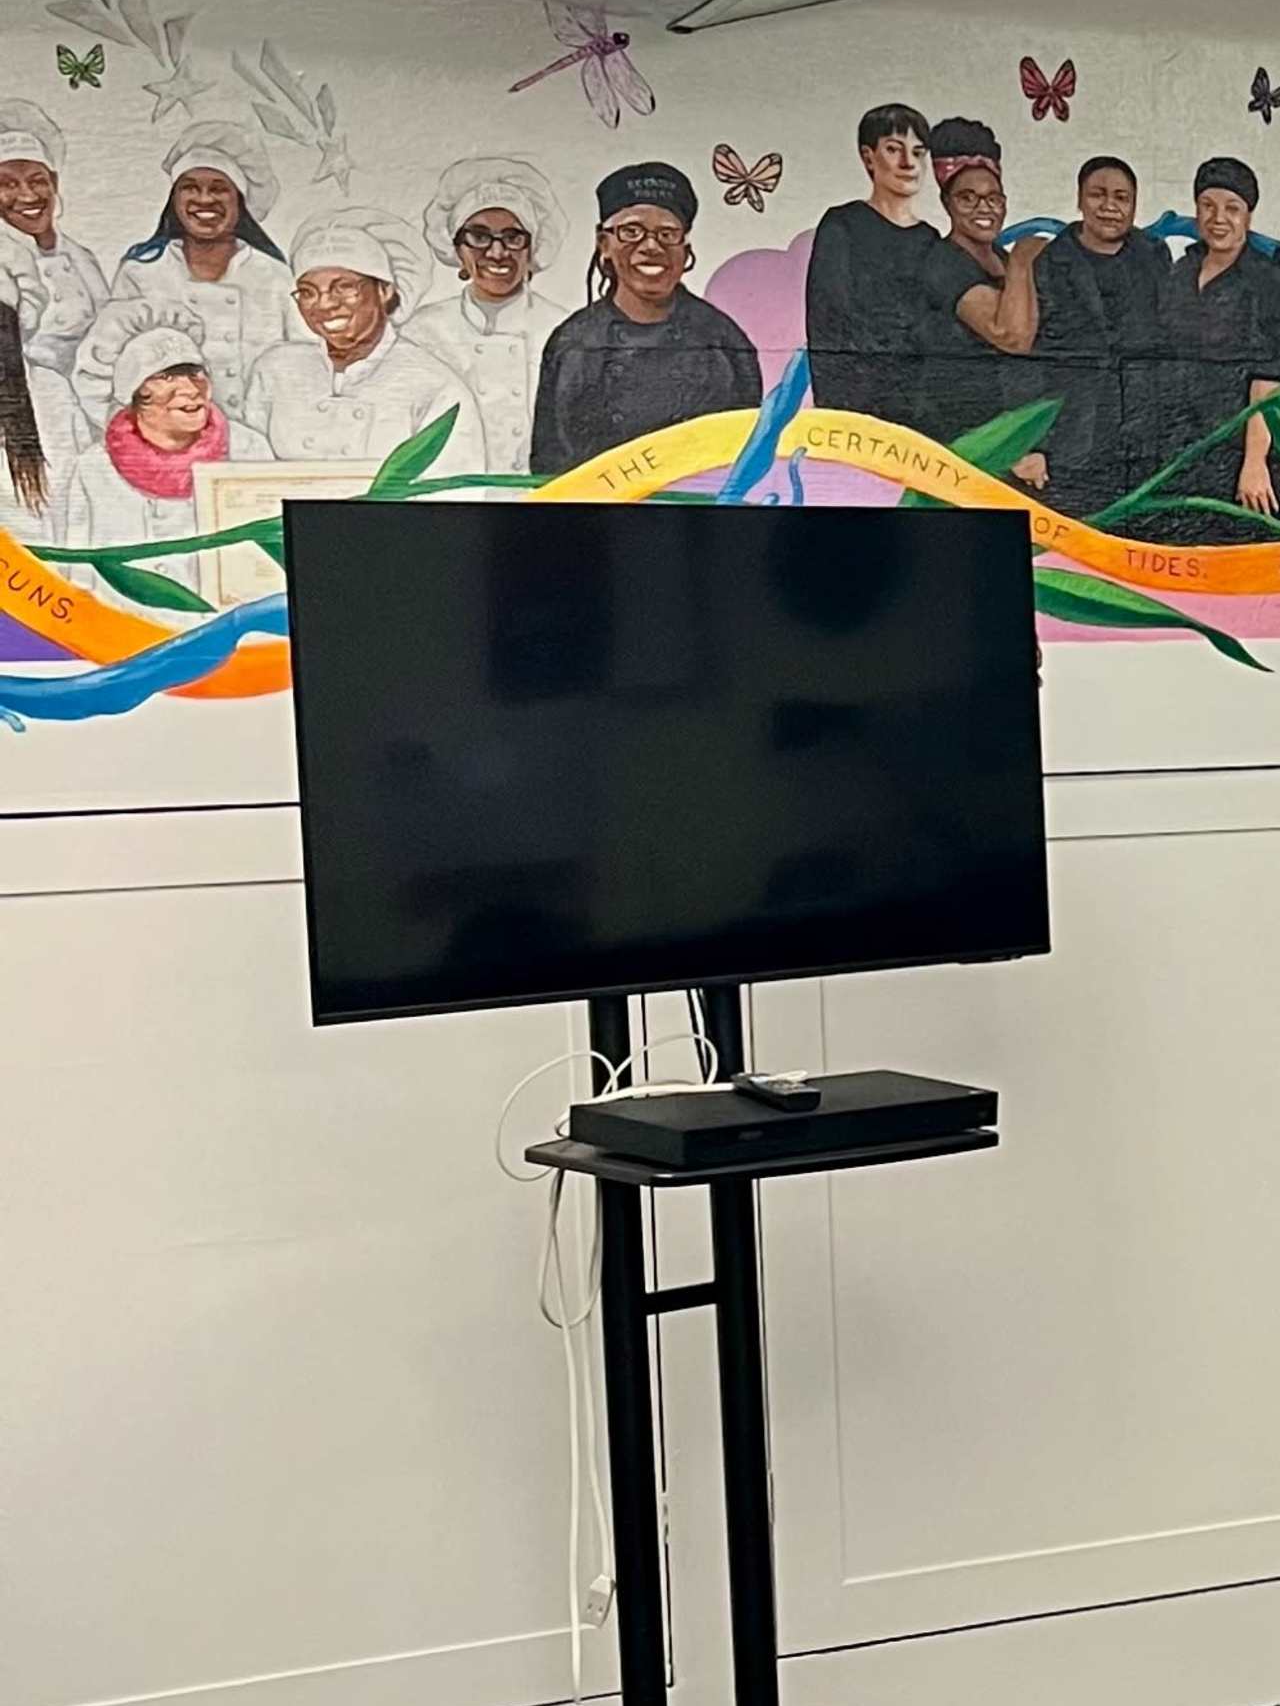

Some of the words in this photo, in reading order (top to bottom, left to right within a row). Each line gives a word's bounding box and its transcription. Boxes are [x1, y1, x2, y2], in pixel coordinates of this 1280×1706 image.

[596, 446, 662, 491] THE
[806, 425, 970, 488] CERTAINTY
[1034, 516, 1070, 542] OF
[0, 558, 75, 624] UNS,
